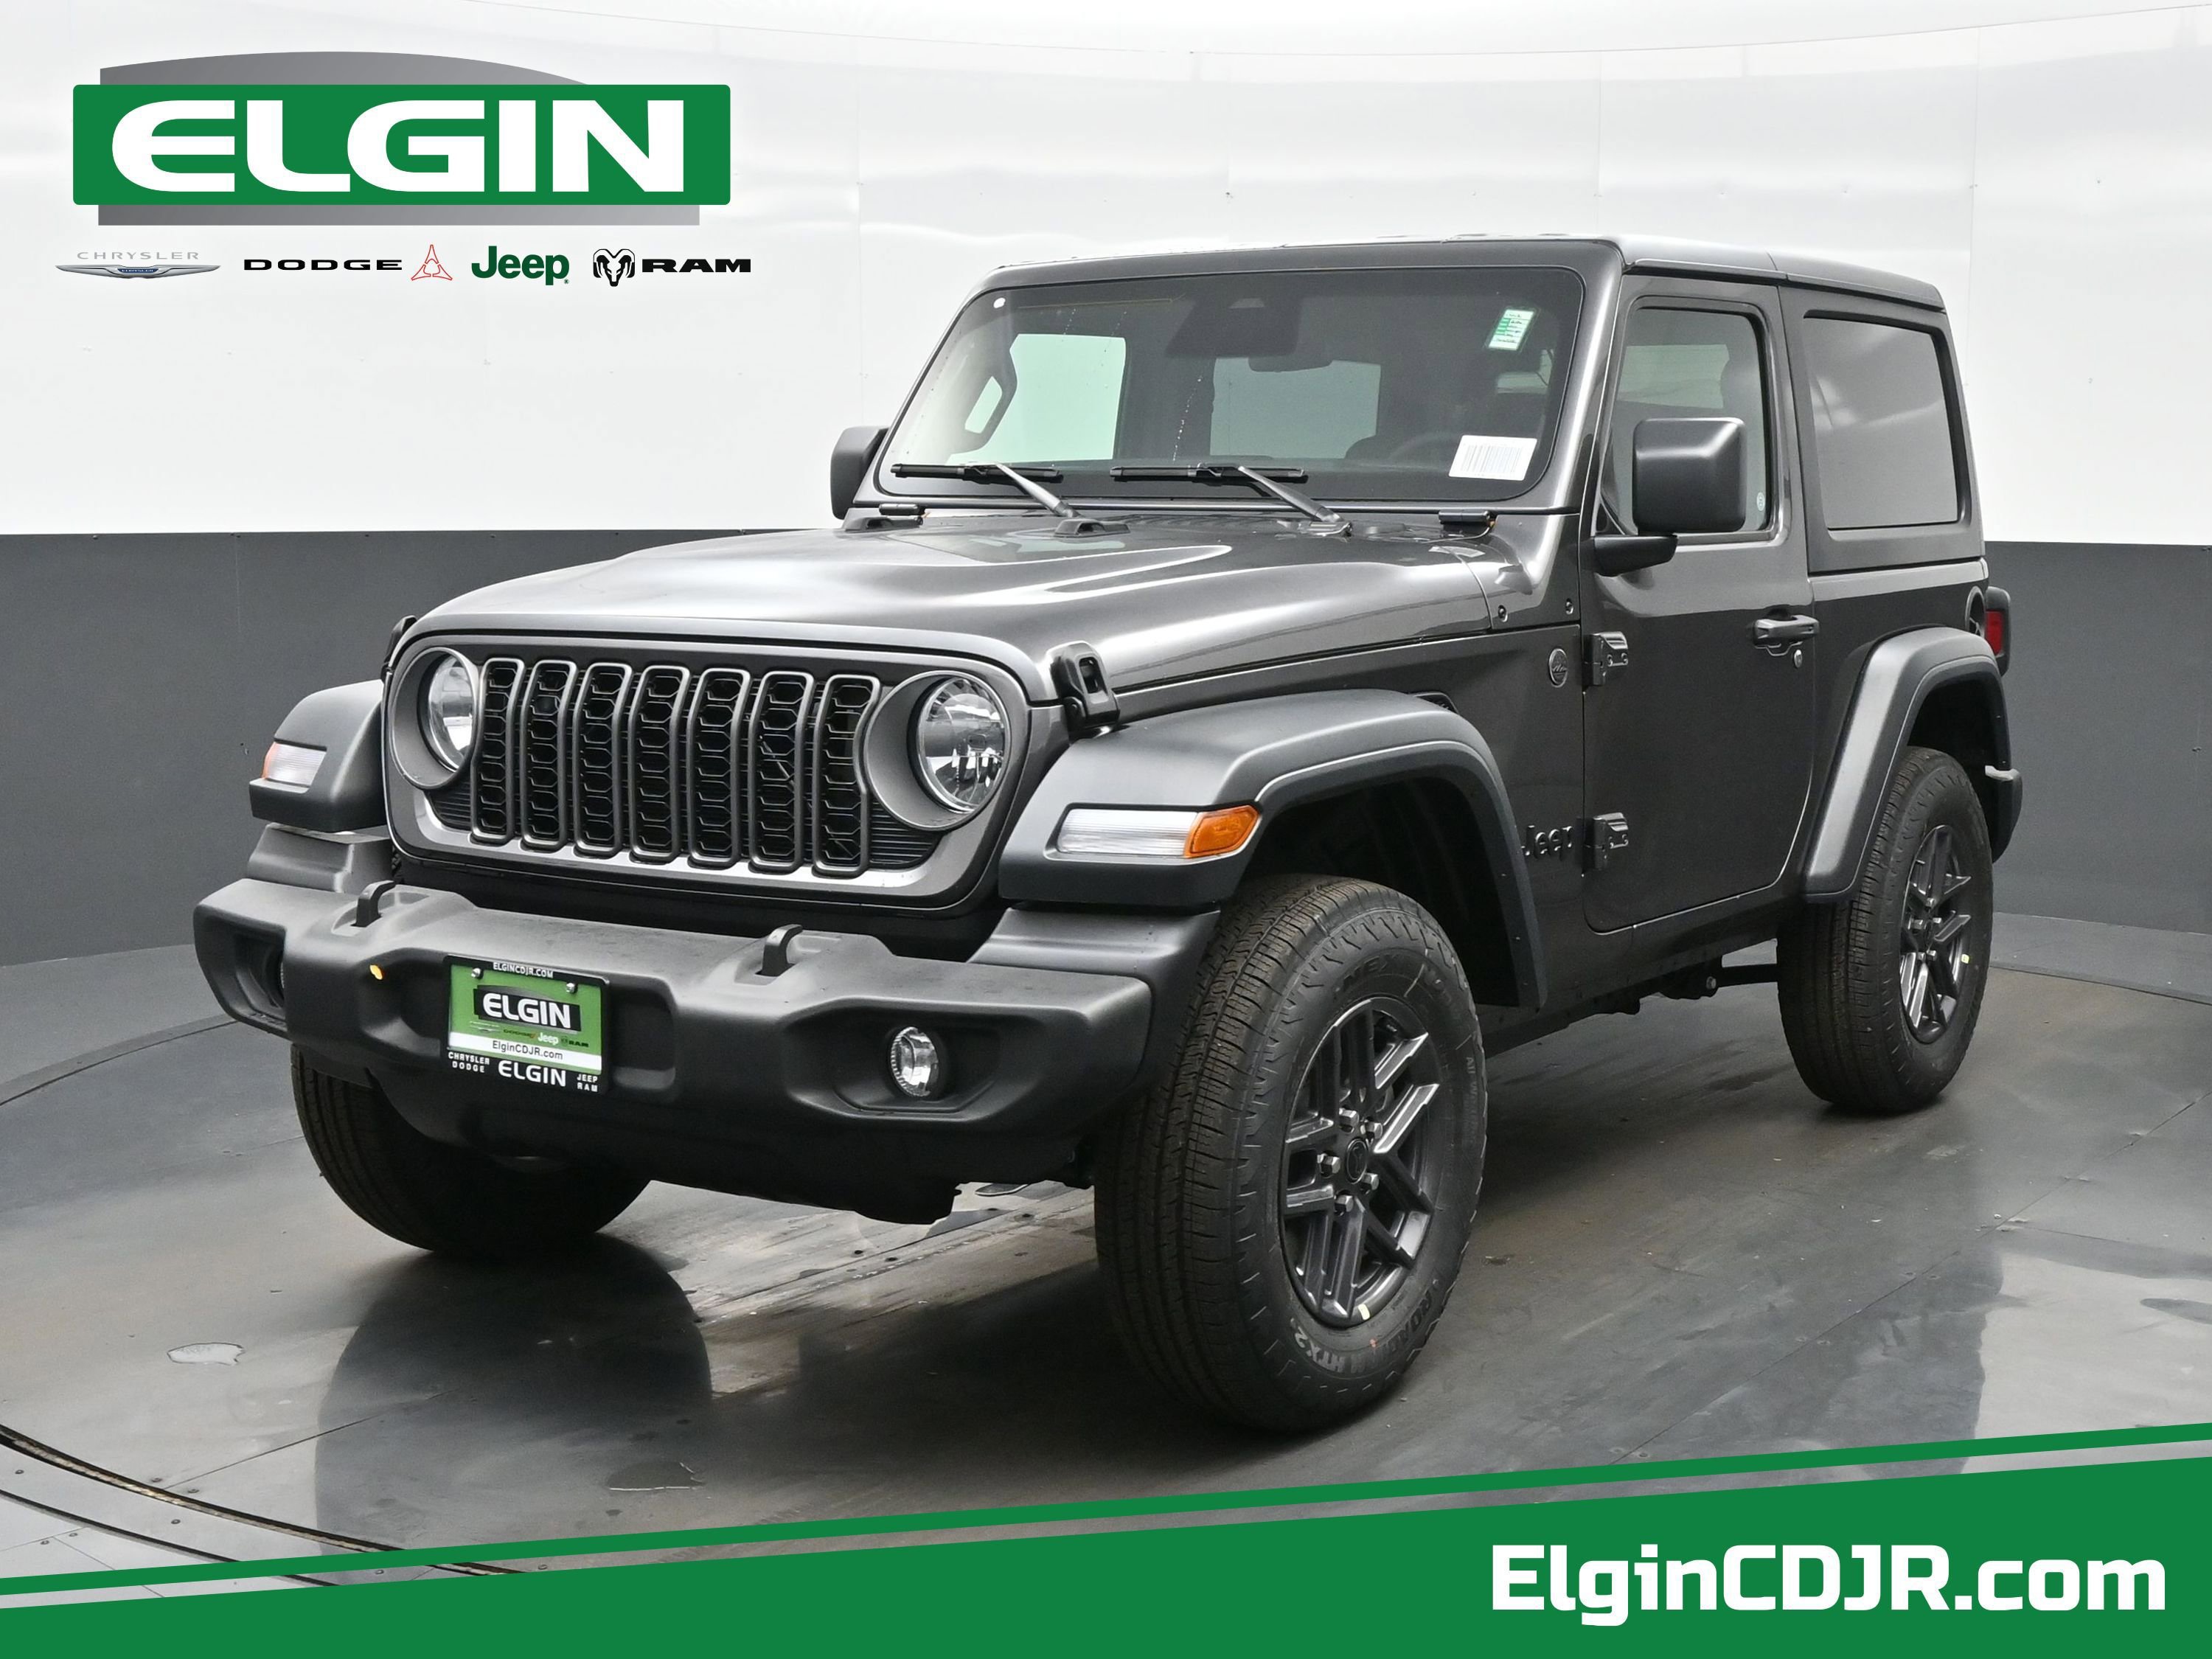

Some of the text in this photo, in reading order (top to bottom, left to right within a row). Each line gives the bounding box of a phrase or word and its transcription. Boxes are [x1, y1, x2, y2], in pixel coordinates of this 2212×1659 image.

[493, 961, 554, 979] ELGINCDJR.COM
[483, 992, 571, 1029] ELGIN
[538, 1032, 559, 1046] Jeep
[492, 1040, 563, 1060] ElginCDJR.com
[448, 1051, 490, 1065] CHRYSLER
[452, 1061, 485, 1074] DODGE
[498, 1060, 566, 1087] ELGIN
[577, 1074, 598, 1083] JEEP
[577, 1082, 598, 1093] RAM
